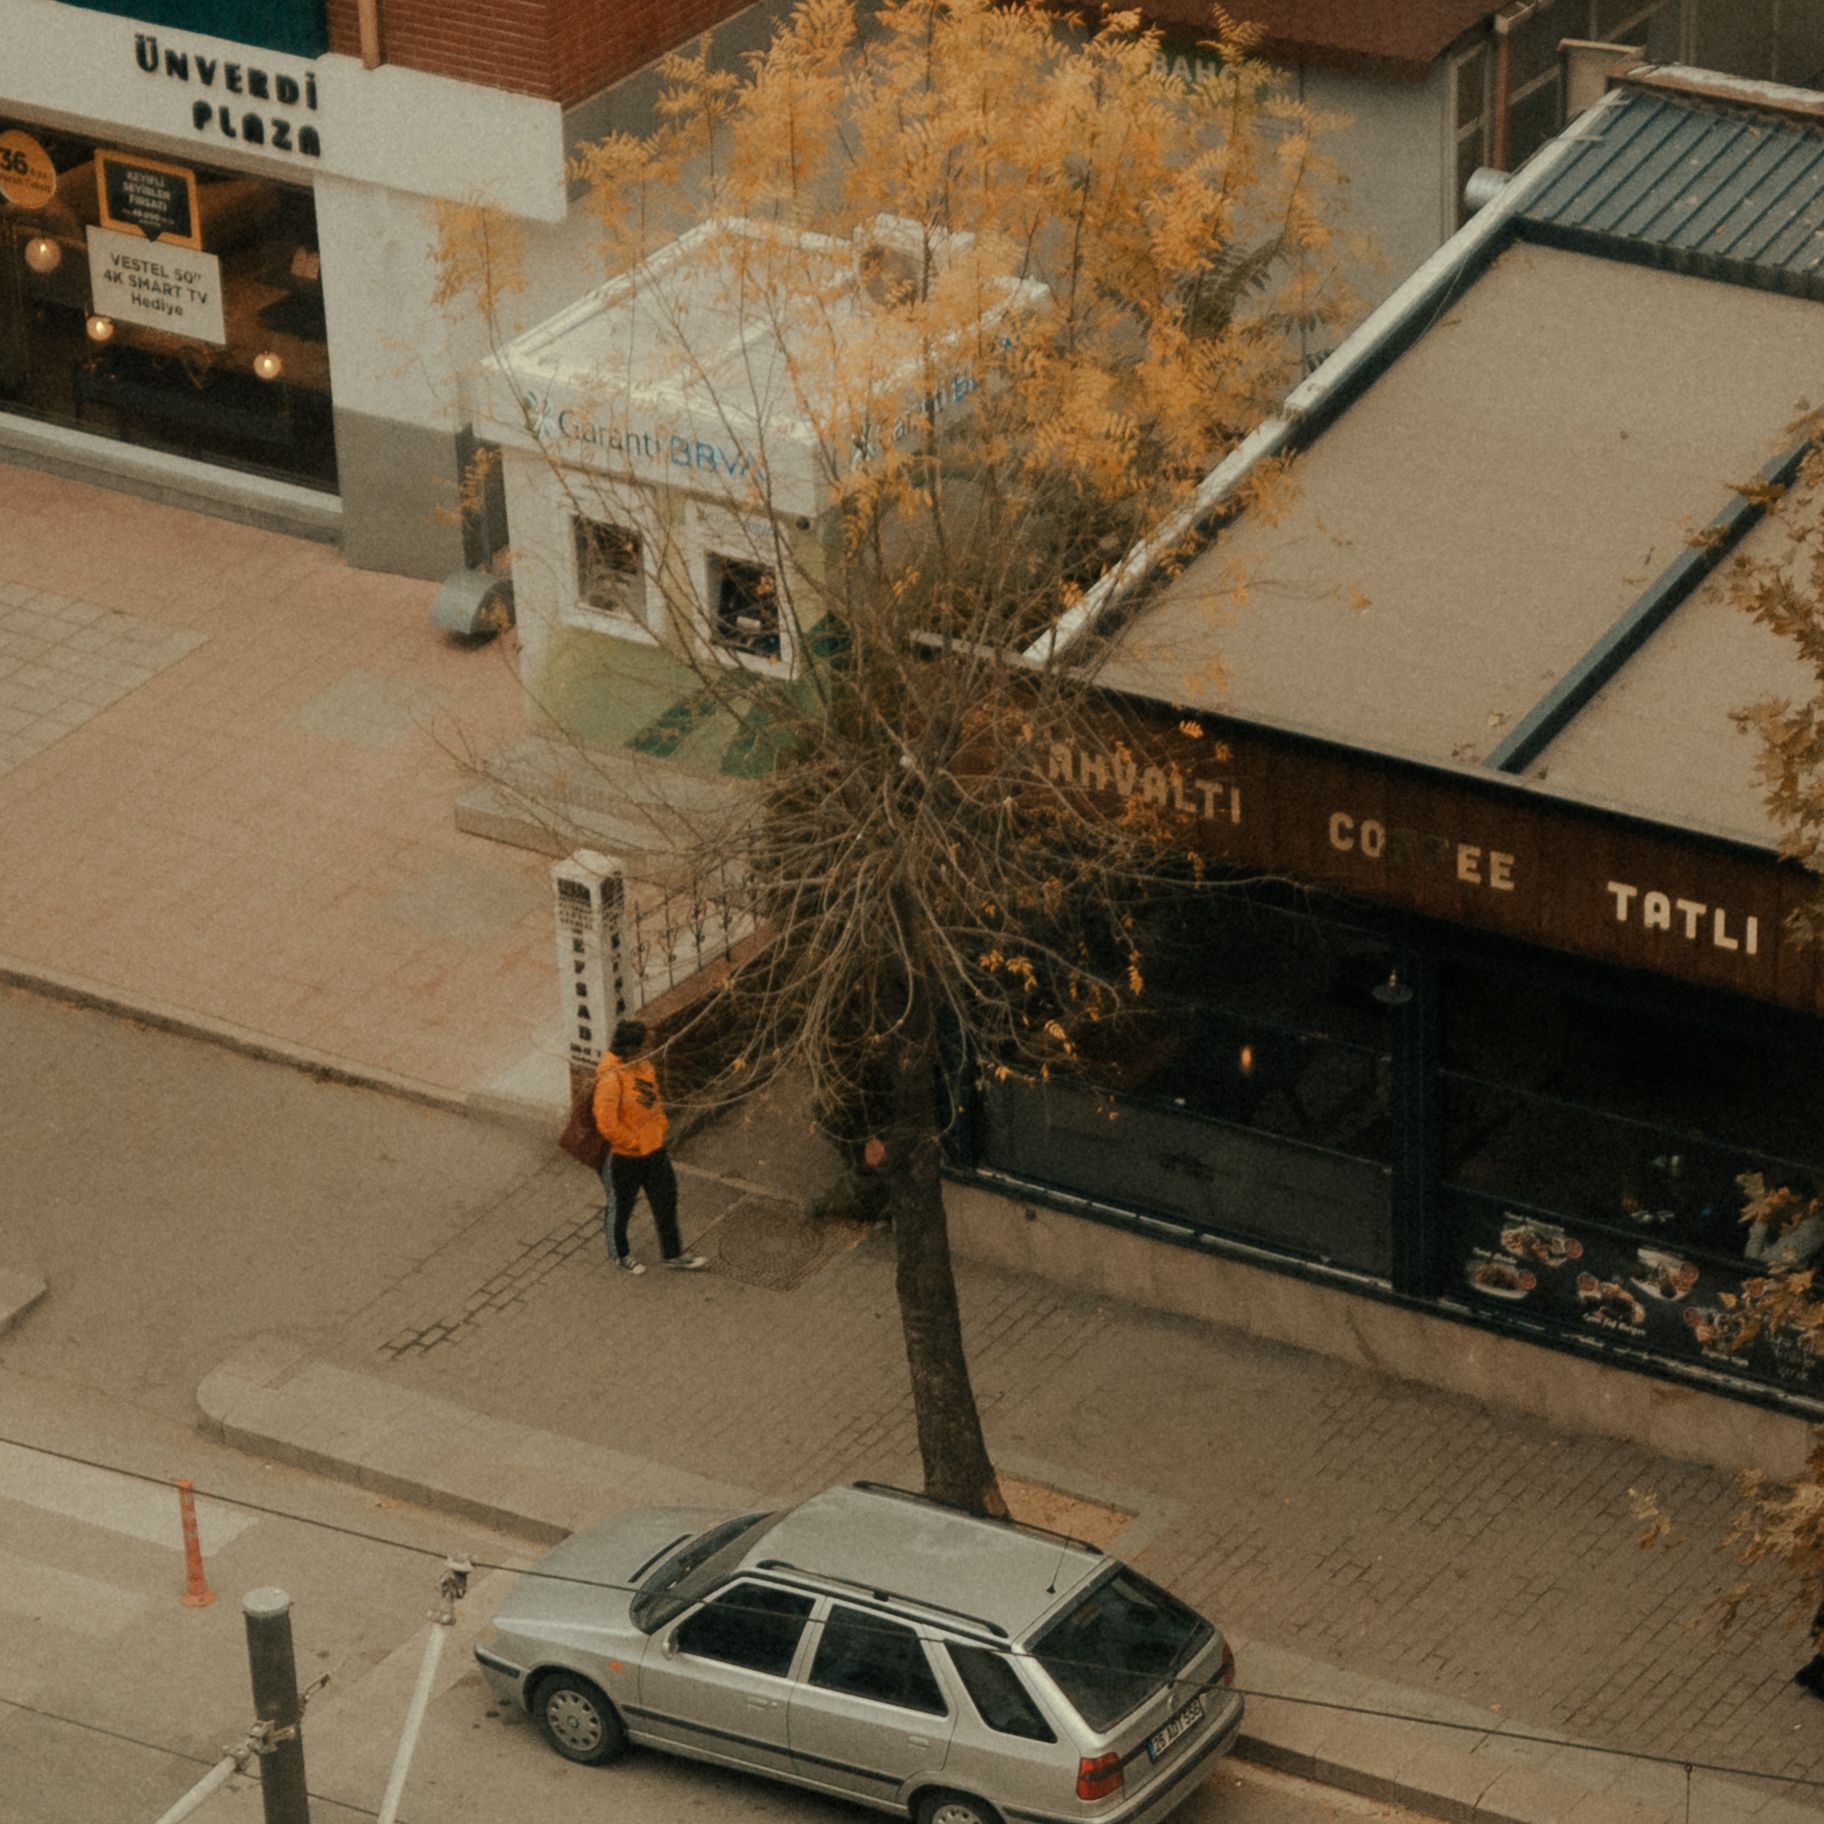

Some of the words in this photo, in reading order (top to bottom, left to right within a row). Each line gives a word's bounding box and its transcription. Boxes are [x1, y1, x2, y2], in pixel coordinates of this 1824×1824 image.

[134, 33, 319, 111] ÜNVERDİ
[192, 101, 321, 157] PLAZA
[103, 269, 124, 284] 4K
[128, 275, 183, 298] SMART
[187, 288, 208, 304] TV
[110, 252, 169, 278] VESTEL
[131, 291, 184, 316] Hediye
[558, 409, 661, 458] Garanti
[1034, 743, 1242, 825] AHVALTI
[1607, 880, 1760, 956] TATLI
